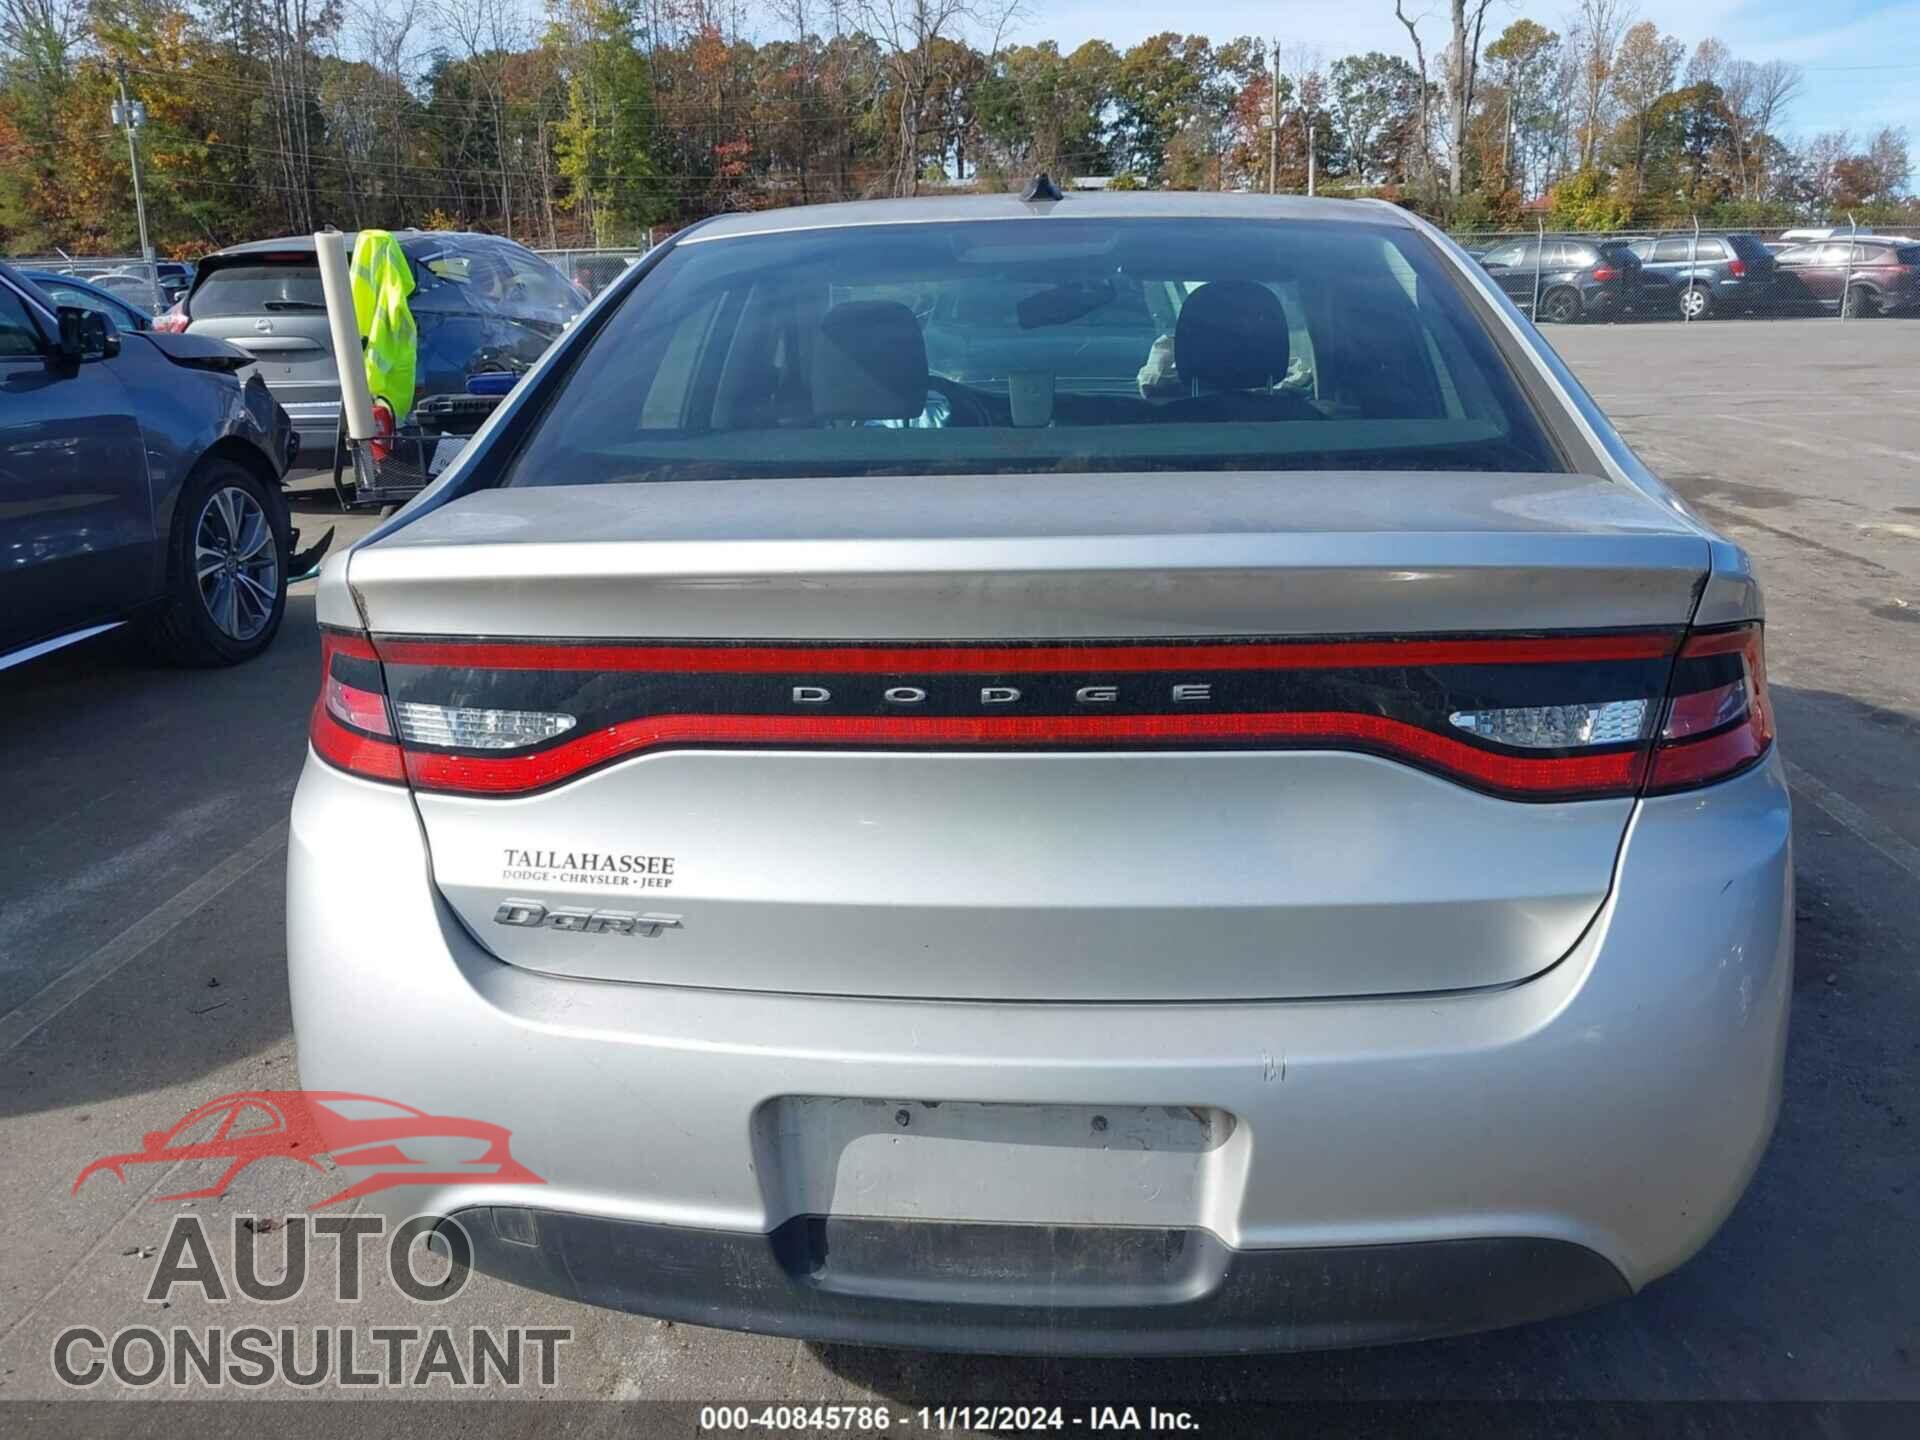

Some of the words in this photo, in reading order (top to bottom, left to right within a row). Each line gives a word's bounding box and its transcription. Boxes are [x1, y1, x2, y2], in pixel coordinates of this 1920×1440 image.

[793, 684, 1212, 703] DODGE
[504, 849, 675, 875] TALLAHASSEE
[503, 870, 550, 881] DODGE
[560, 873, 629, 886] CHRYSLER
[641, 877, 672, 888] JEEP
